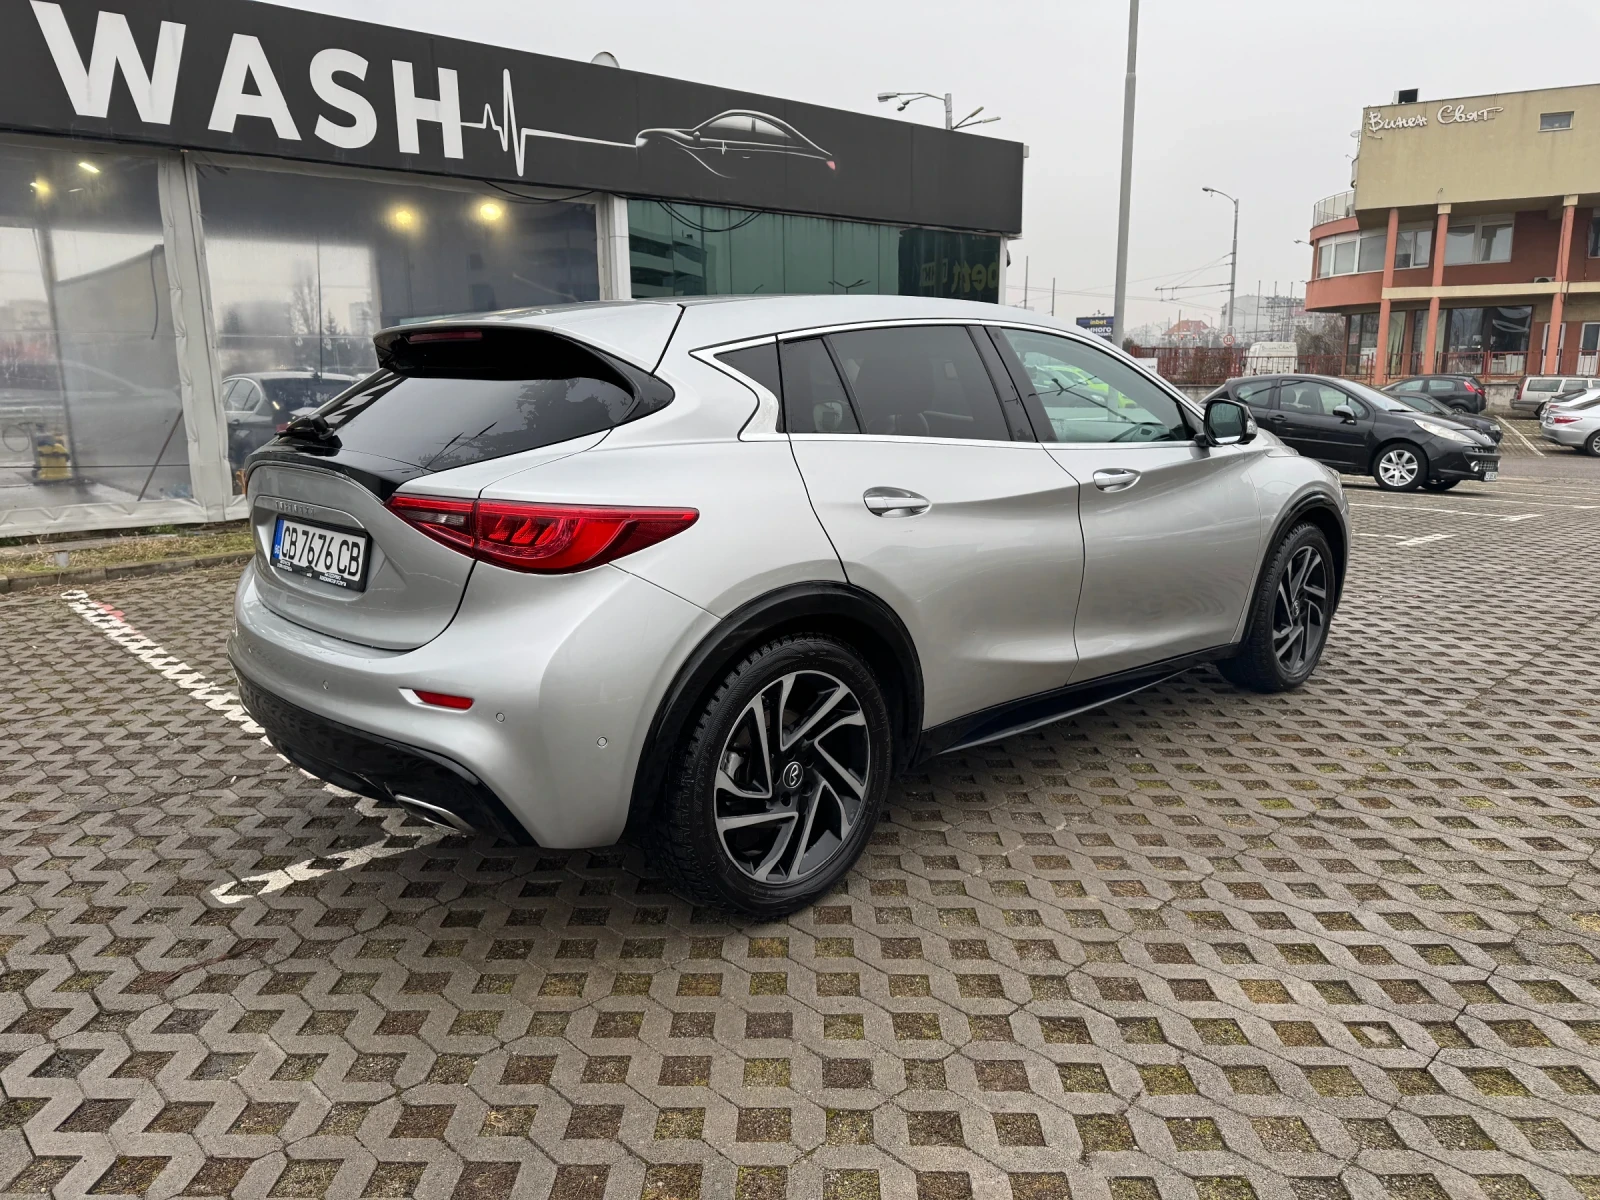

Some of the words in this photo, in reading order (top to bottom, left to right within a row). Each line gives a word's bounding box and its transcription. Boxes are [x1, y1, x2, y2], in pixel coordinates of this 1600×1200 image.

[30, 0, 465, 160] WASH
[1368, 111, 1428, 132] Винен
[1437, 104, 1504, 124] Свят
